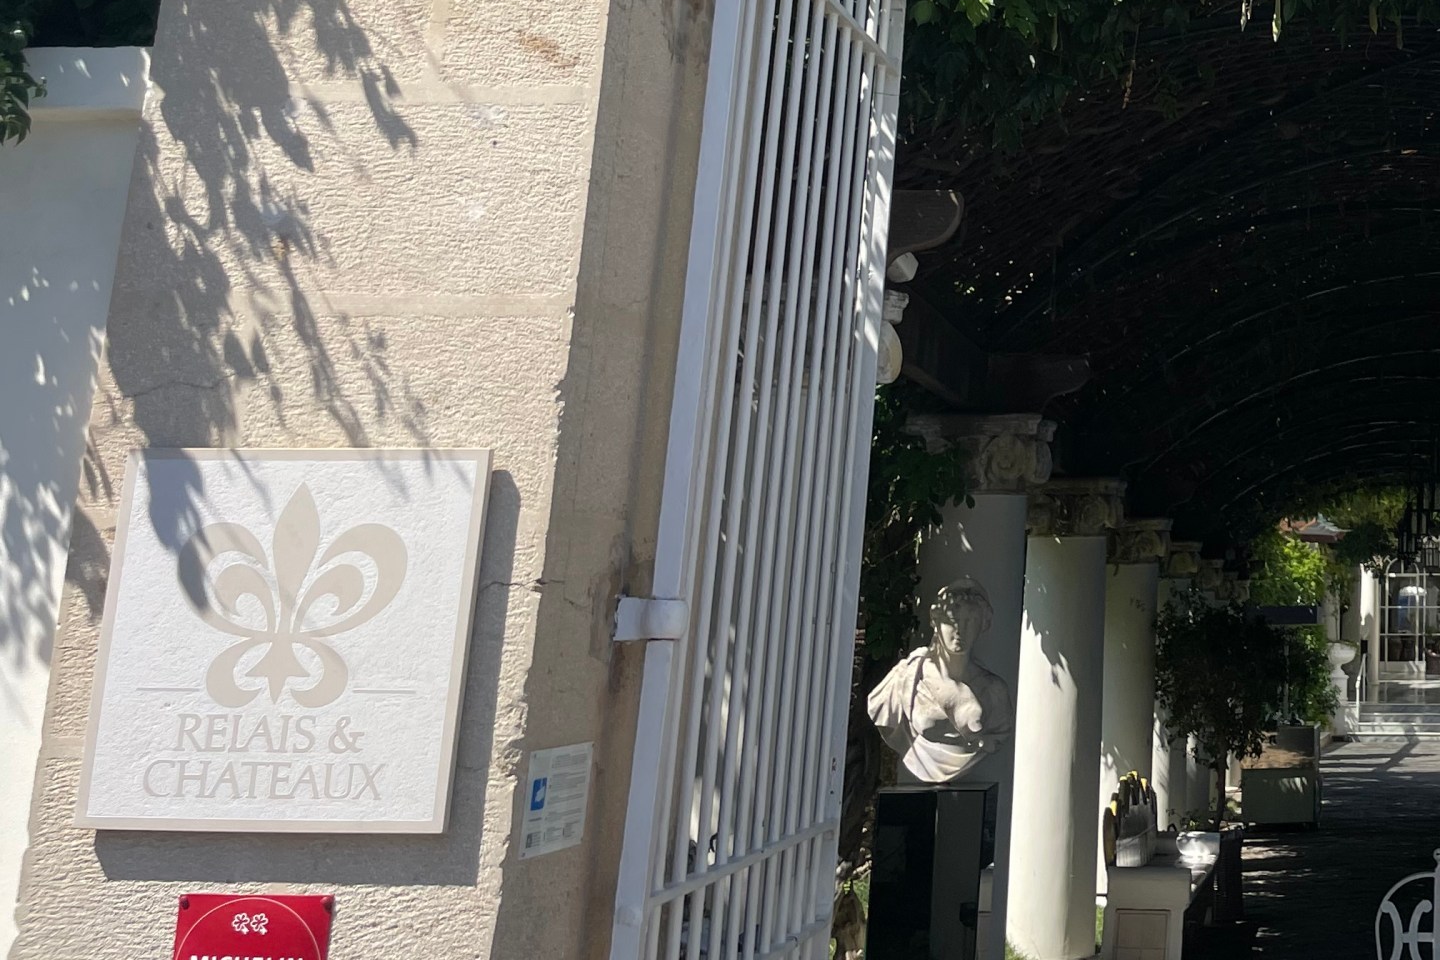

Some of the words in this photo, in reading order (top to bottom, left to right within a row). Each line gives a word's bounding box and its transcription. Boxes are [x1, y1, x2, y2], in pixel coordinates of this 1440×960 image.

[173, 713, 317, 754] RELAIS
[327, 715, 365, 754] &
[142, 759, 386, 801] CHATEAUX
